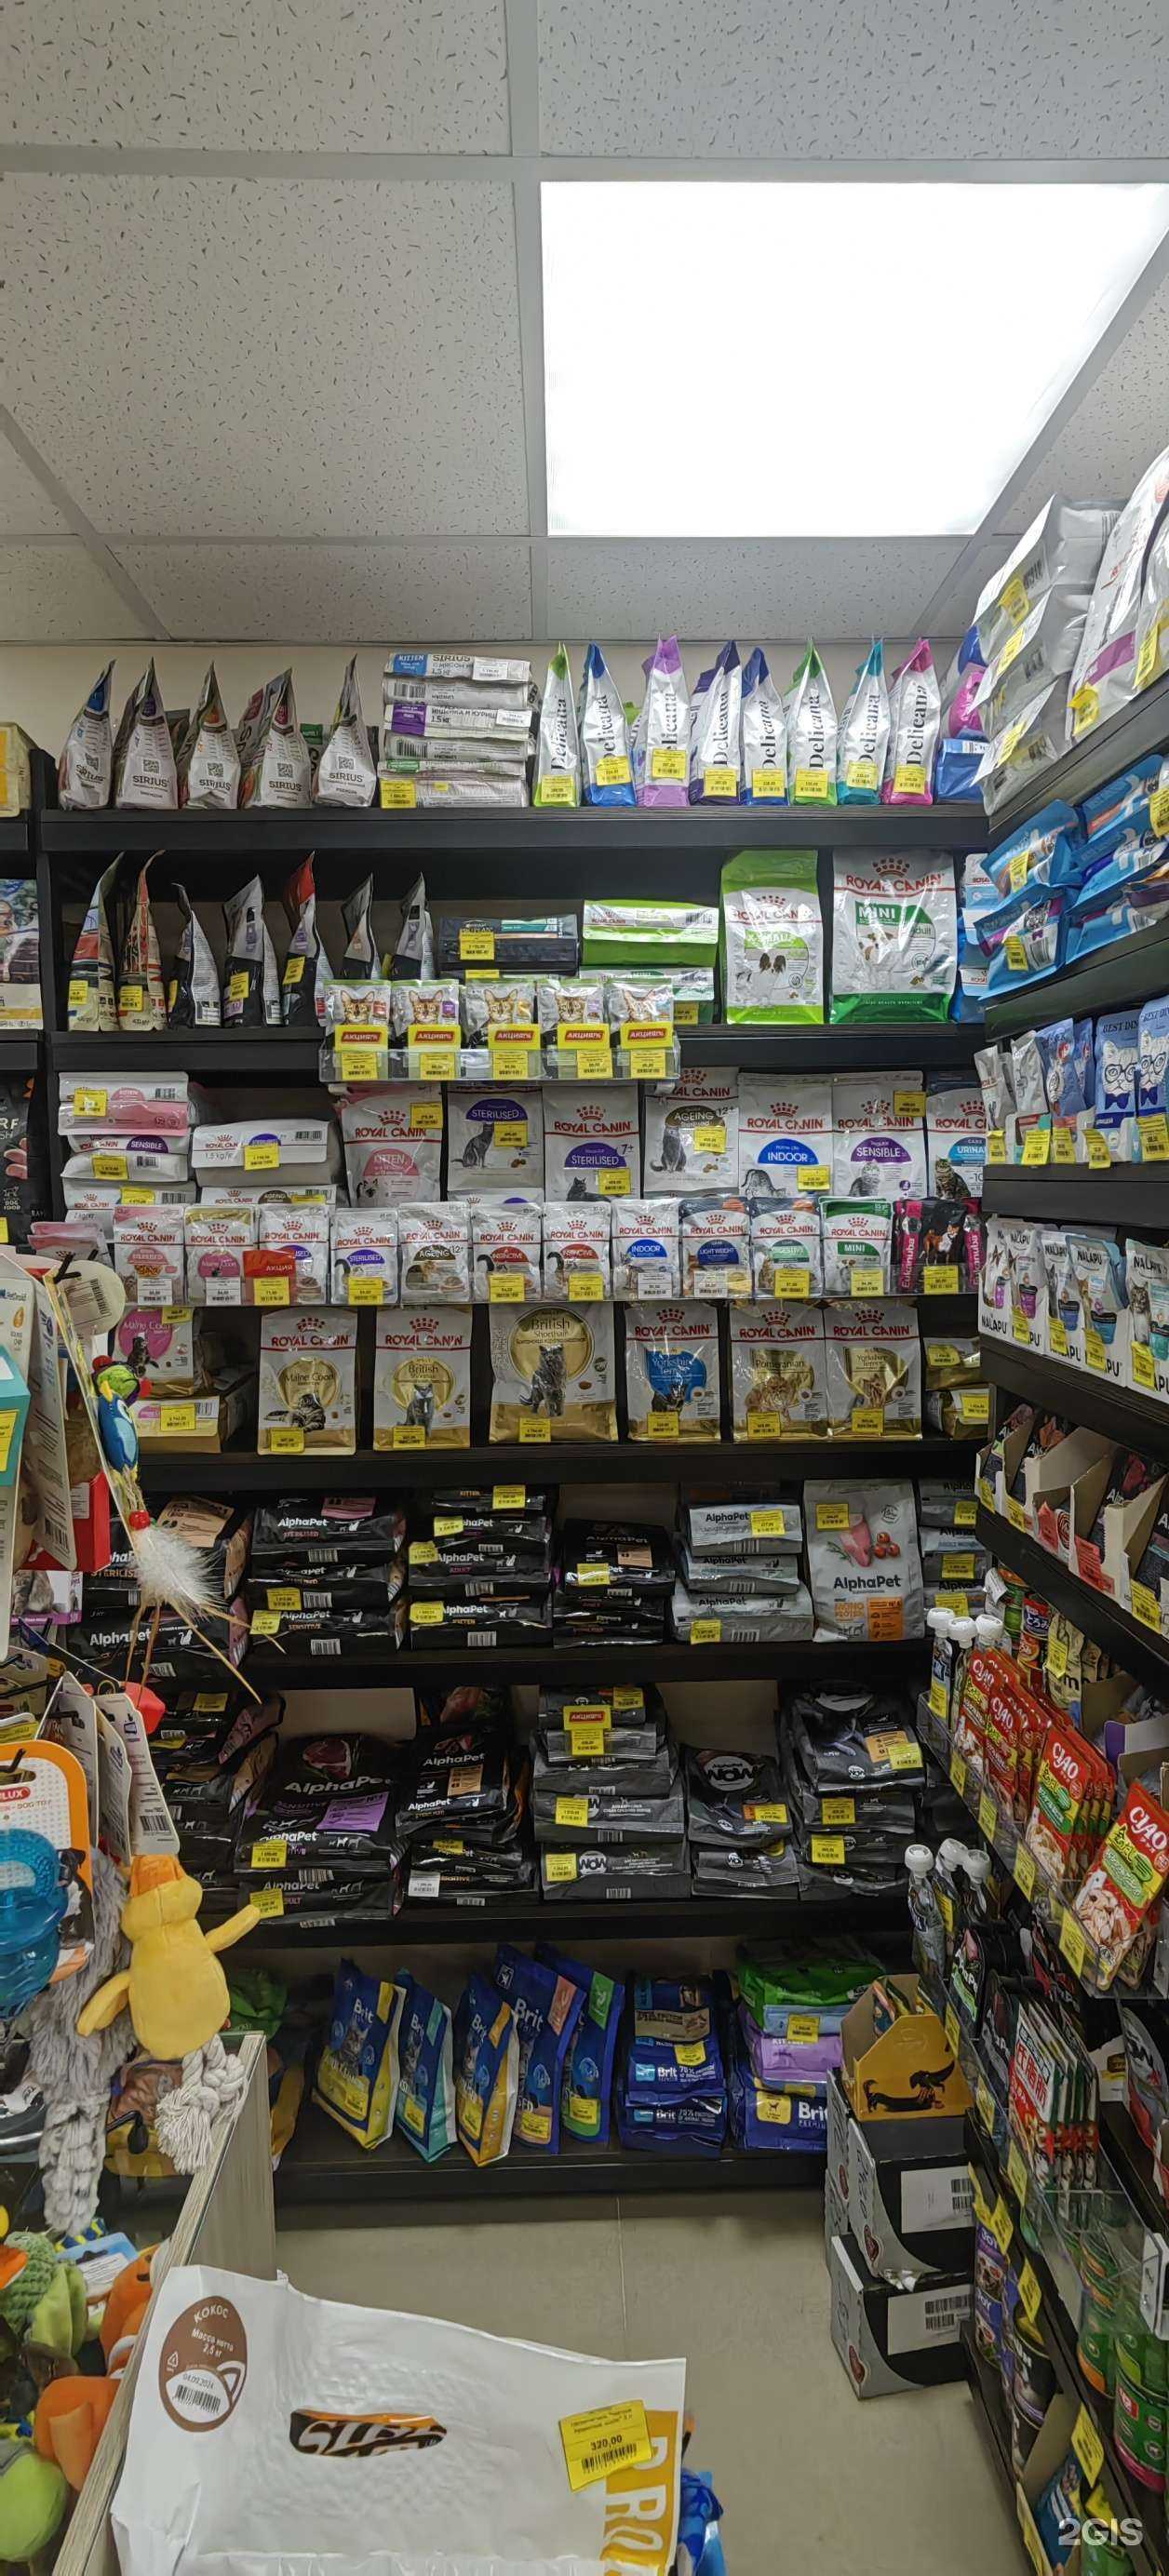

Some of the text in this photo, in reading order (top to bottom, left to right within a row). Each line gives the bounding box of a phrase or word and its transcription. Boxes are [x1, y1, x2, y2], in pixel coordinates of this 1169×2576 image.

[713, 690, 730, 766] Delicana
[907, 682, 927, 765] Delicana
[809, 692, 825, 768] Delicana
[133, 774, 168, 787] SIRIUS
[329, 771, 363, 783] SIRIUS
[268, 779, 302, 791] SIRIUS
[847, 872, 942, 892] ROYAL CANIN
[858, 906, 895, 919] MINI
[1122, 1019, 1138, 1032] DIN
[692, 1087, 731, 1097] CANIN
[472, 1109, 521, 1119] STERILISED
[674, 1111, 714, 1121] AGEING
[554, 1120, 632, 1133] ROYAL CANIN
[747, 1118, 824, 1130] ROYAL CANIN
[935, 1118, 973, 1130] ROYAL
[355, 1127, 427, 1138] ROYAL CANIN
[131, 1141, 163, 1150] SENSIBLE
[957, 1146, 984, 1155] URINA
[768, 1151, 808, 1163] INDOOR
[856, 1147, 902, 1158] SENSIBLE
[571, 1155, 619, 1166] STERILISED
[264, 1232, 320, 1241] ROYAL CANIN
[406, 1231, 460, 1241] ROYAL CANIN
[550, 1231, 575, 1240] ROYAL
[619, 1227, 673, 1235] ROYAL CANIN
[690, 1226, 745, 1235] ROYAL CANIN
[759, 1226, 813, 1236] ROYAL CANIN
[831, 1228, 886, 1238] ROYAL CANIN
[120, 1234, 176, 1242] ROYAL CANIN
[191, 1235, 246, 1244] ROYAL CANIN
[337, 1236, 391, 1247] ROYAL CANIN
[480, 1233, 534, 1242] ROYAL CANIN
[419, 1249, 450, 1258] AGEING
[631, 1244, 662, 1254] INDOOR
[844, 1243, 867, 1253] MINI
[900, 1236, 916, 1289] Eukanuba
[1077, 1250, 1103, 1266] NALAPU
[531, 1317, 571, 1330] British
[981, 1315, 1008, 1335] NALAPU
[635, 1324, 710, 1337] ROYAL CANIN
[739, 1326, 815, 1338] ROYAL CANIN
[833, 1325, 910, 1336] ROYAL CANIN
[271, 1333, 308, 1347] ROYAL
[384, 1334, 464, 1347] ROYAL CANIN
[408, 1362, 439, 1375] British
[755, 1359, 805, 1368] Pomeranian
[285, 1372, 310, 1383] Maine
[278, 1517, 327, 1528] AlphaPet
[463, 1518, 494, 1527] phaPet
[705, 1512, 750, 1523] AlphaPet
[704, 1556, 747, 1565] AlphaPet
[90, 1569, 138, 1578] STERILIS
[834, 1575, 902, 1591] AlphaPet
[699, 1596, 747, 1607] AlphaPet
[281, 1610, 330, 1621] AlphaPet
[973, 1659, 994, 1687] CIAO
[992, 1697, 1014, 1729] CIAO
[423, 1752, 486, 1766] AlphaPet
[1053, 1742, 1080, 1779] CIAO
[408, 1798, 451, 1811] AlphaPet
[1129, 1805, 1168, 1851] CIAO
[354, 1998, 374, 2023] Brit
[515, 1997, 544, 2032] Brit
[658, 2067, 678, 2077] Brit
[656, 2109, 676, 2120] Brit
[194, 2304, 229, 2324] КОКОС
[192, 2328, 216, 2343] Масса
[203, 2343, 215, 2355] 2,5
[591, 2435, 623, 2451] 320,00
